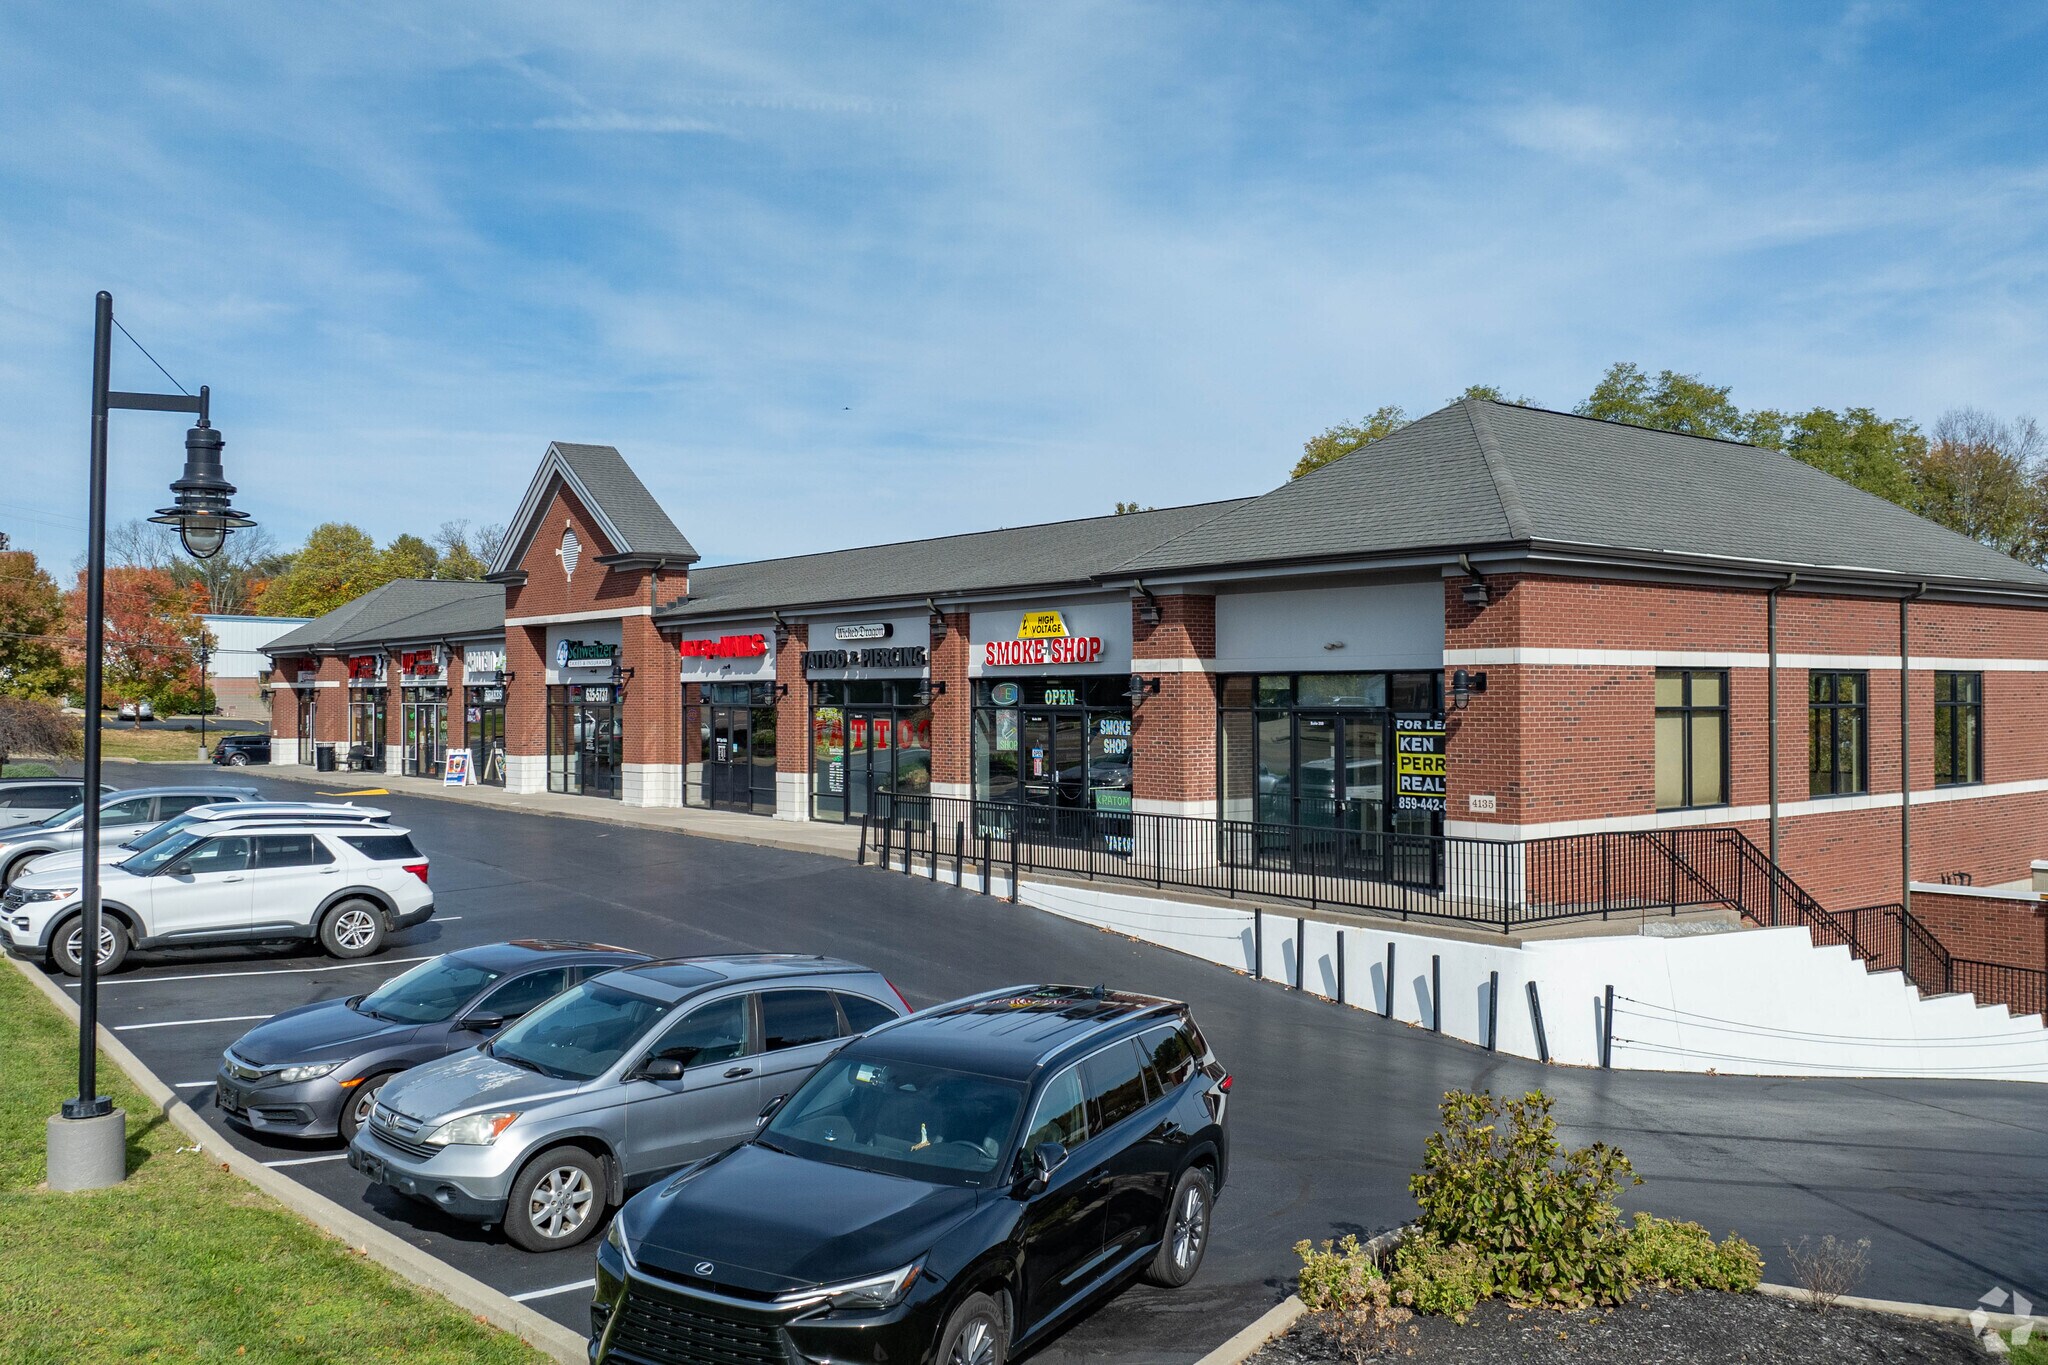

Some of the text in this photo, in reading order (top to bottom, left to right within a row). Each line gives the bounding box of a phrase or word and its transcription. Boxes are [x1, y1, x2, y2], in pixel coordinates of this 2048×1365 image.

[1037, 615, 1054, 624] HIGH
[837, 626, 884, 638] Wicked Dragon
[1031, 624, 1061, 634] VOLTAGE
[801, 646, 926, 669] TATTOO & PIERCING
[985, 636, 1102, 666] SMOKE SHOP
[1045, 689, 1075, 705] OPEN
[1100, 719, 1131, 736] SMOKE
[1396, 719, 1422, 730] FOR
[1000, 740, 1018, 750] SHOP
[1103, 738, 1128, 754] SHOP
[1400, 736, 1434, 752] KEN
[1401, 776, 1446, 792] REAL
[1097, 793, 1131, 806] KRATOM
[1472, 799, 1494, 809] 4135
